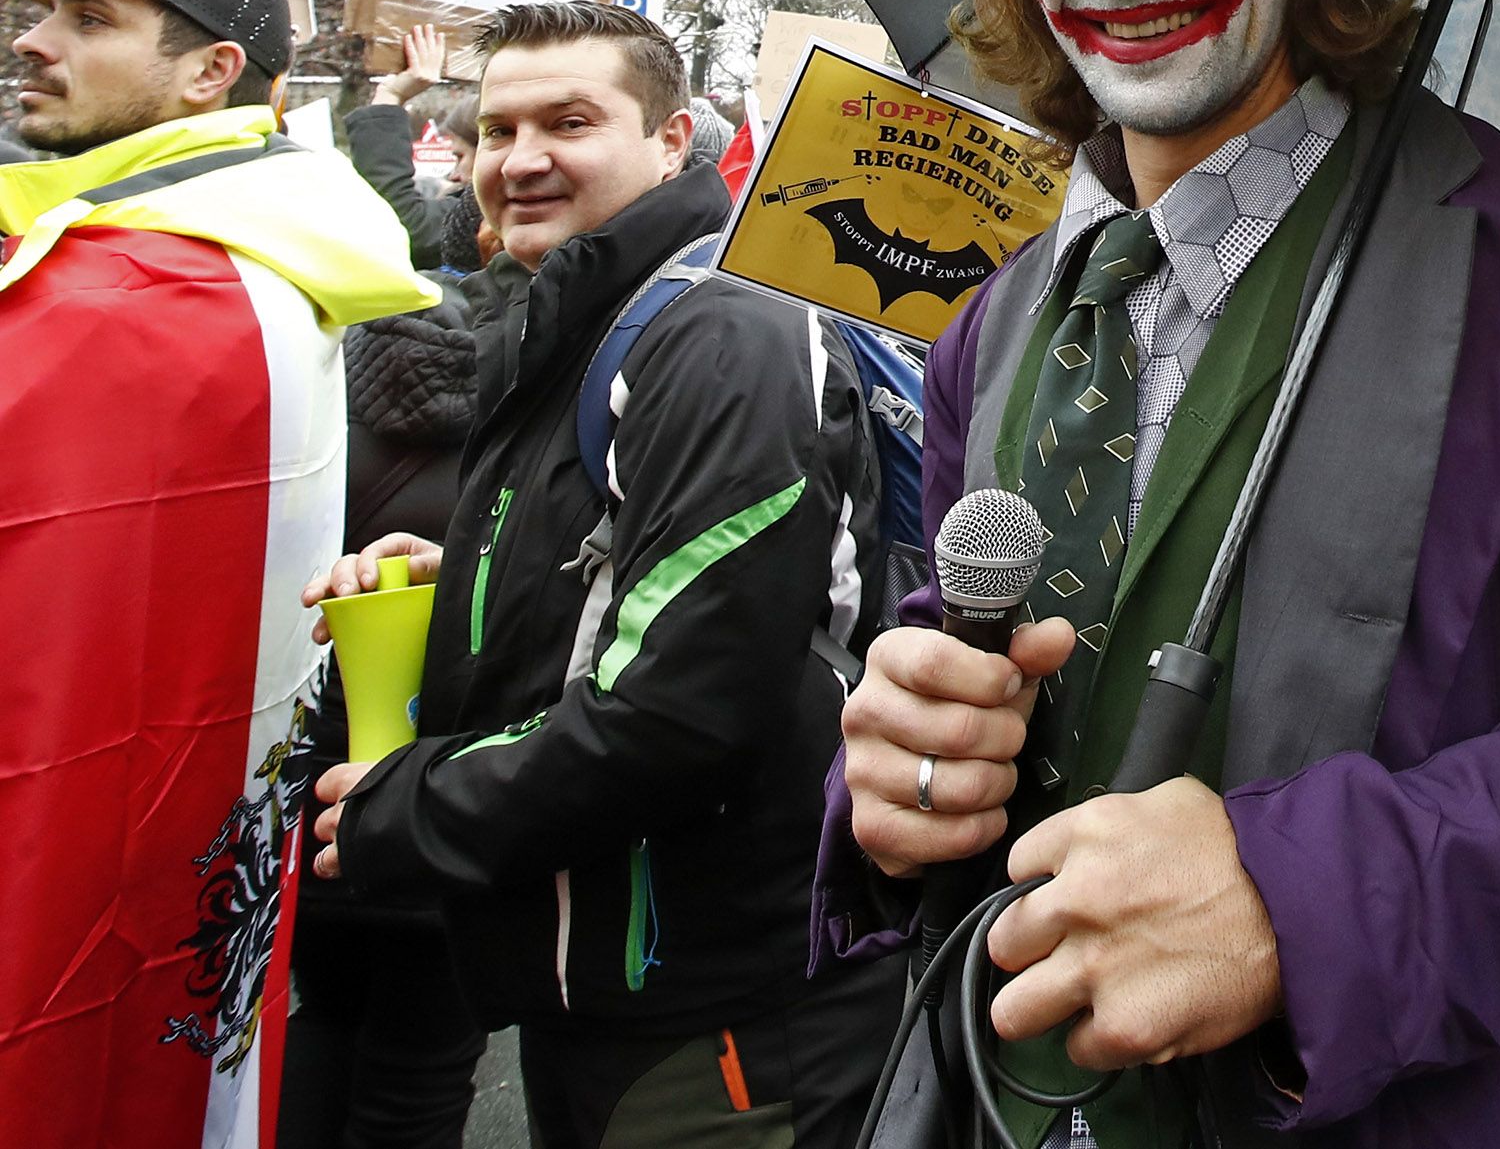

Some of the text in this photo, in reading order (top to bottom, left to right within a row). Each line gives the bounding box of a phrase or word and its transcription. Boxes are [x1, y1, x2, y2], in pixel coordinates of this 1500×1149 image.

[853, 149, 1014, 223] REGIERUNG
[877, 125, 1014, 190] BAD MAN
[964, 123, 1056, 196] DIESE
[833, 212, 986, 279] STOPPT IMPF ZWANG
[961, 609, 1006, 620] SHURE
